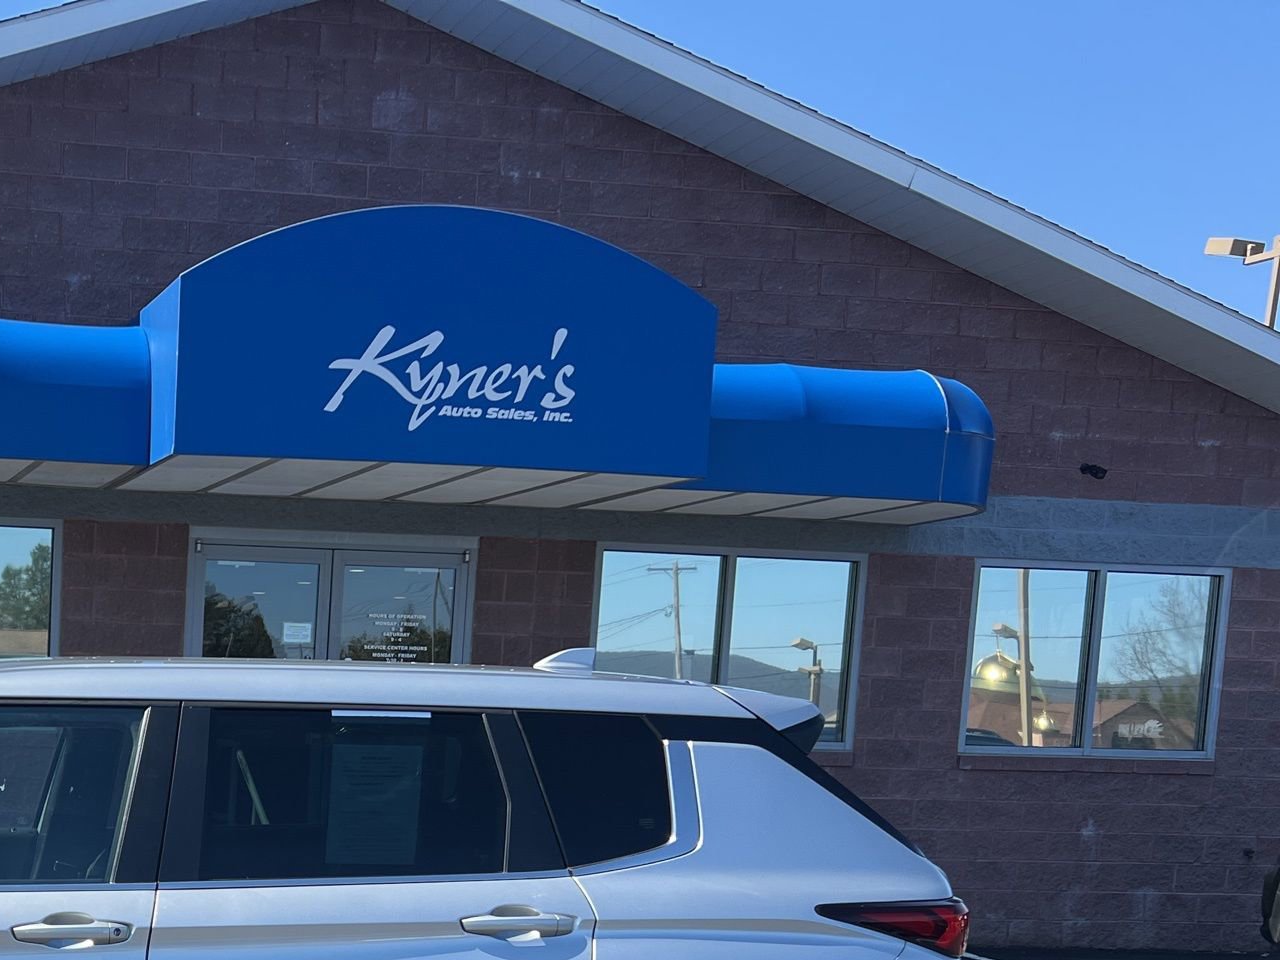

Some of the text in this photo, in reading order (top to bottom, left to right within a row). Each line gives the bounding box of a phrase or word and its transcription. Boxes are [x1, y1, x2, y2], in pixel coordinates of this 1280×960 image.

[323, 324, 576, 432] Kyner's
[438, 404, 574, 423] Auto Sales, Inc.
